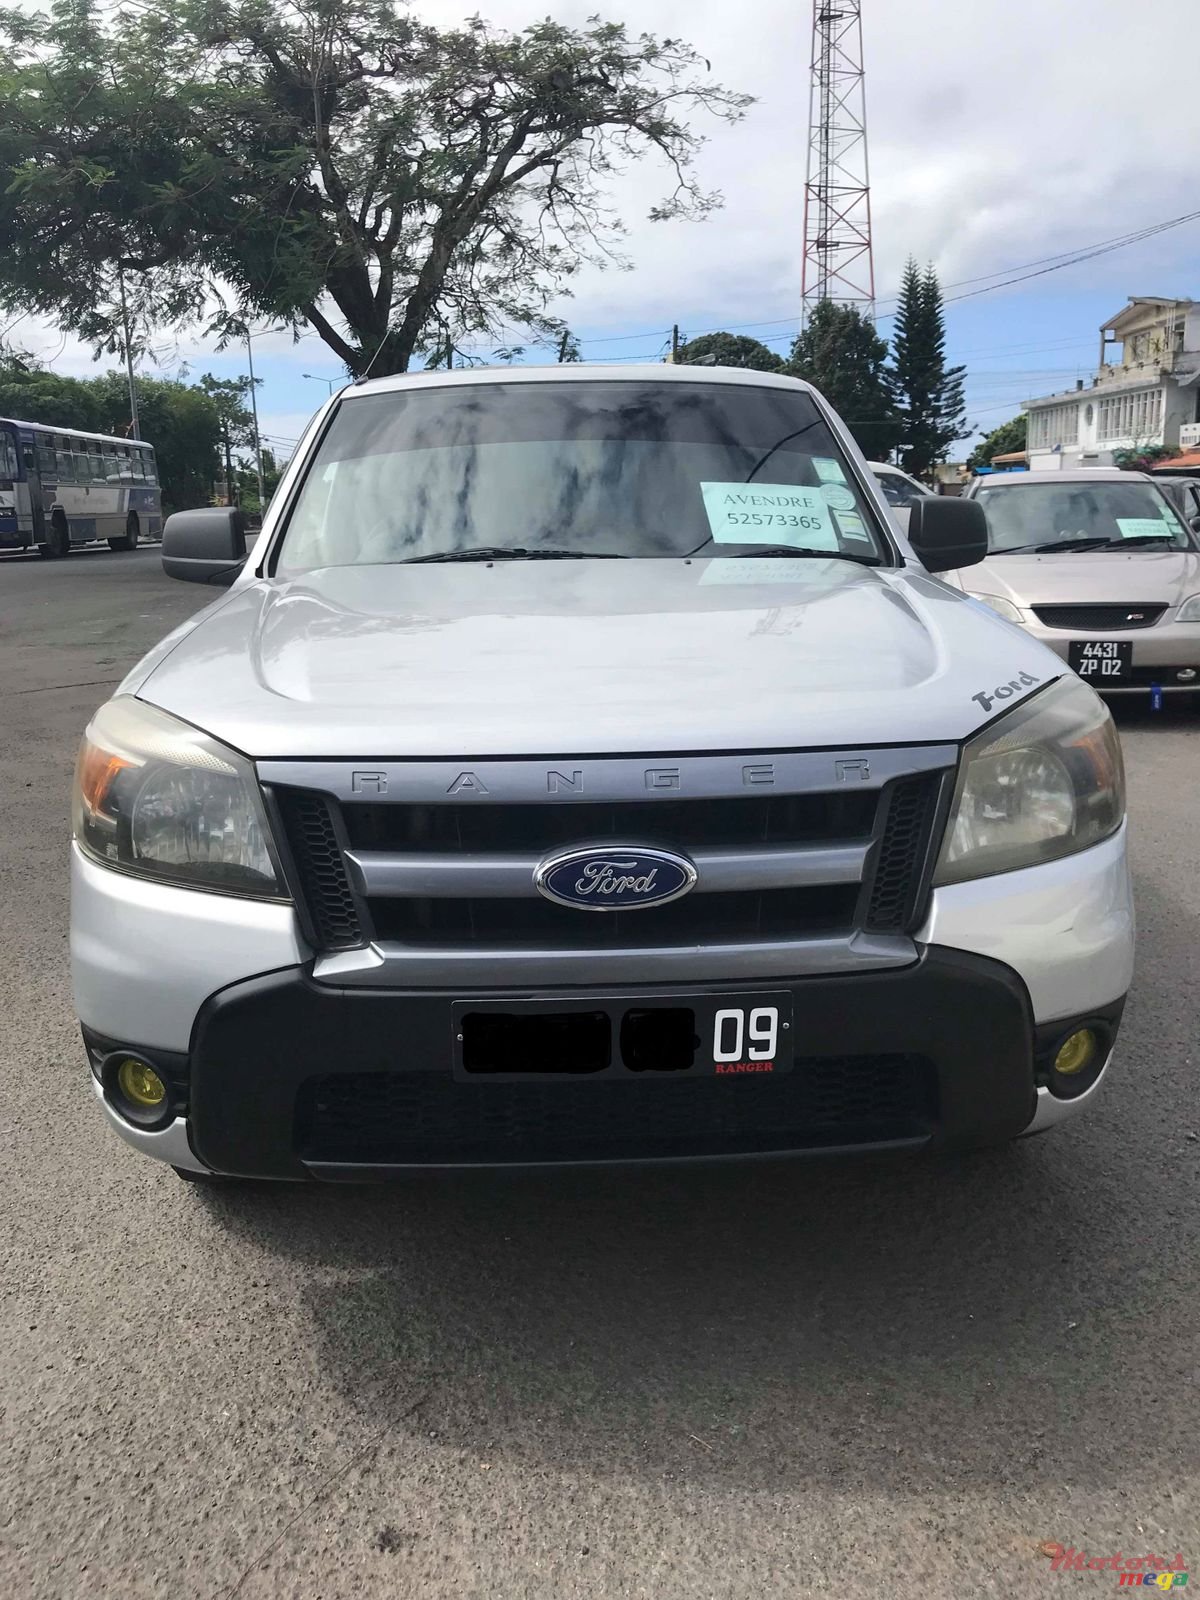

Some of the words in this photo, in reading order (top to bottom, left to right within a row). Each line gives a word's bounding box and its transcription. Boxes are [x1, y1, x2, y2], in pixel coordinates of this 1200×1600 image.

[727, 512, 822, 530] 52573365
[1083, 642, 1118, 658] 4431
[1079, 659, 1098, 675] ZP
[1101, 659, 1122, 675] 02
[971, 671, 1040, 712] Ford
[351, 759, 871, 794] RANGER
[575, 861, 658, 895] Ford
[713, 1007, 778, 1062] 09
[715, 1062, 774, 1073] RANGER
